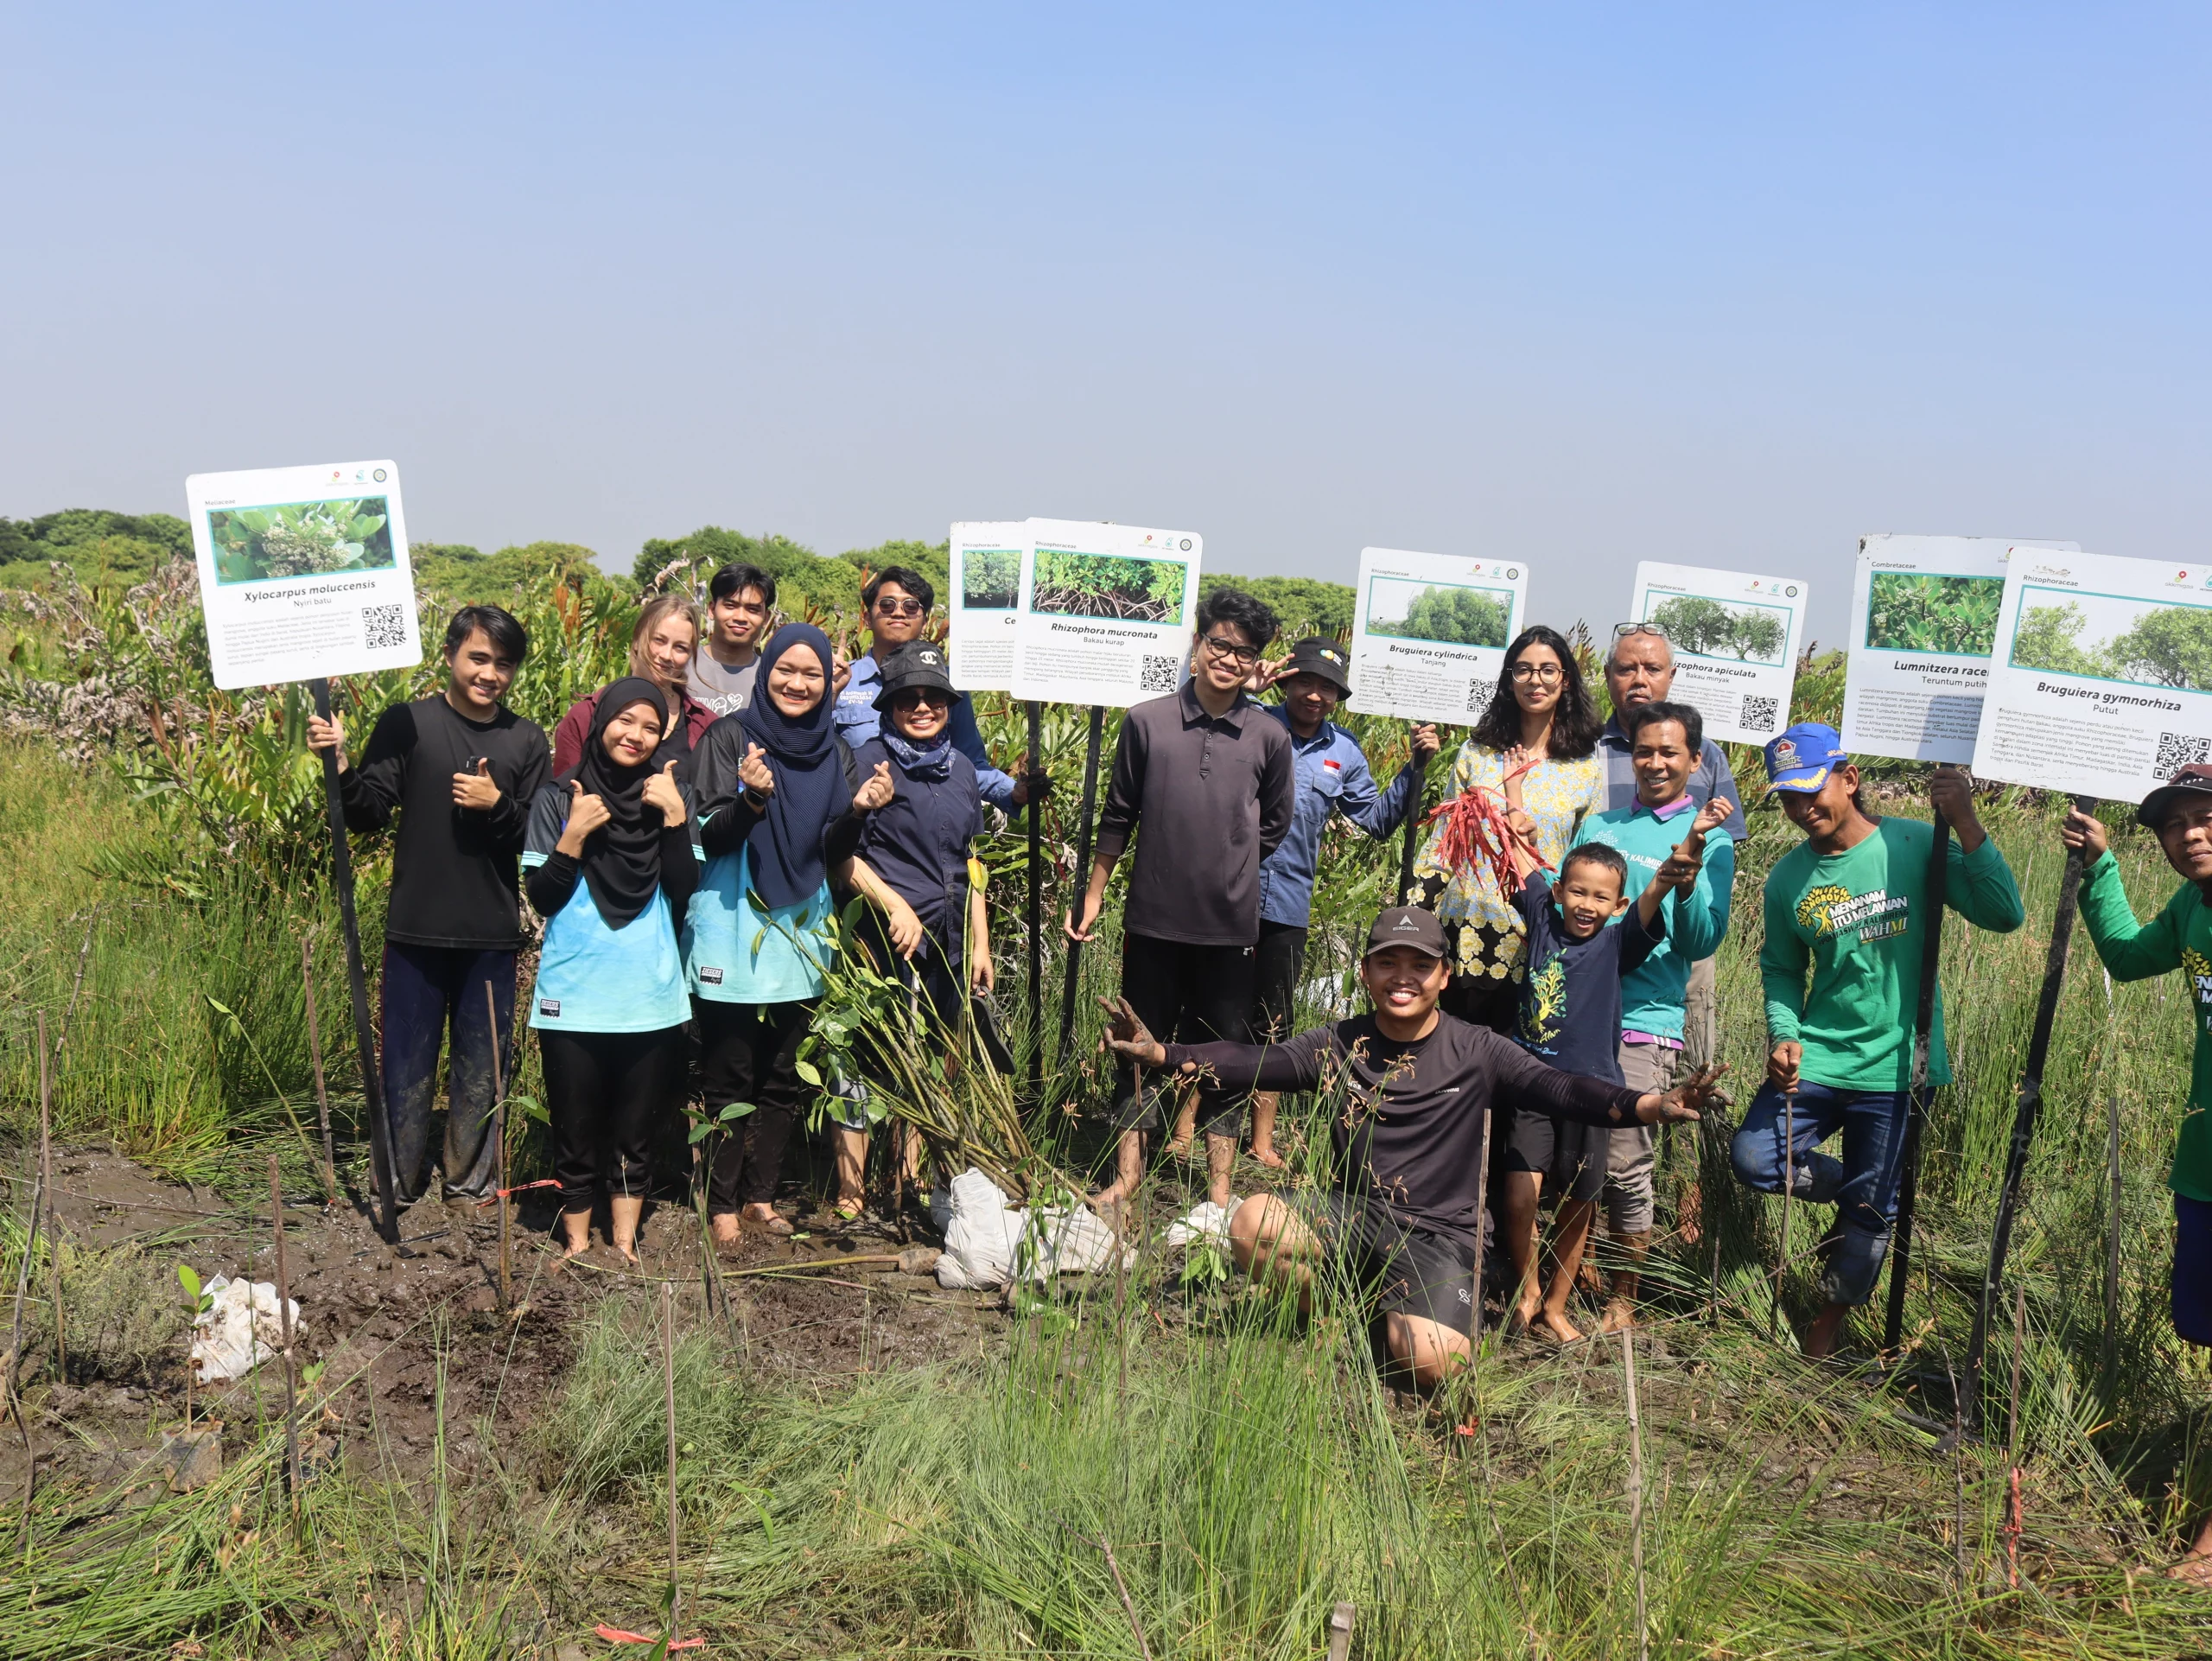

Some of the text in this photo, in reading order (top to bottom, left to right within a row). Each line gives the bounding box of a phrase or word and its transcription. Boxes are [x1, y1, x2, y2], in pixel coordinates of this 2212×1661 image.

[1035, 540, 1077, 549] Rhizophoraceae
[1647, 582, 1686, 591] Rhizophoraceae
[2023, 575, 2078, 587] Rhizophoraceae
[245, 580, 376, 602] Xylocarpus moluccensis
[294, 598, 314, 608] Nyiri
[1051, 623, 1158, 640] Rhizophora mucronata
[1105, 638, 1125, 646] kurap
[1389, 645, 1478, 661] Bruguiera cylindrica
[1421, 659, 1446, 667] Tanjang
[1674, 660, 1756, 678] izophora apiculata
[1894, 660, 1989, 677] Lumnitzera race
[1922, 676, 1987, 689] Teruntum putih
[2037, 682, 2182, 711] Bruguiera gymnorhiza
[2093, 704, 2119, 715] Putut
[1630, 854, 1663, 867] KALIMIR
[1828, 889, 1886, 918] MENANAM
[1832, 896, 1908, 929] ITU MELAWAN
[1859, 917, 1908, 940] WAHMI
